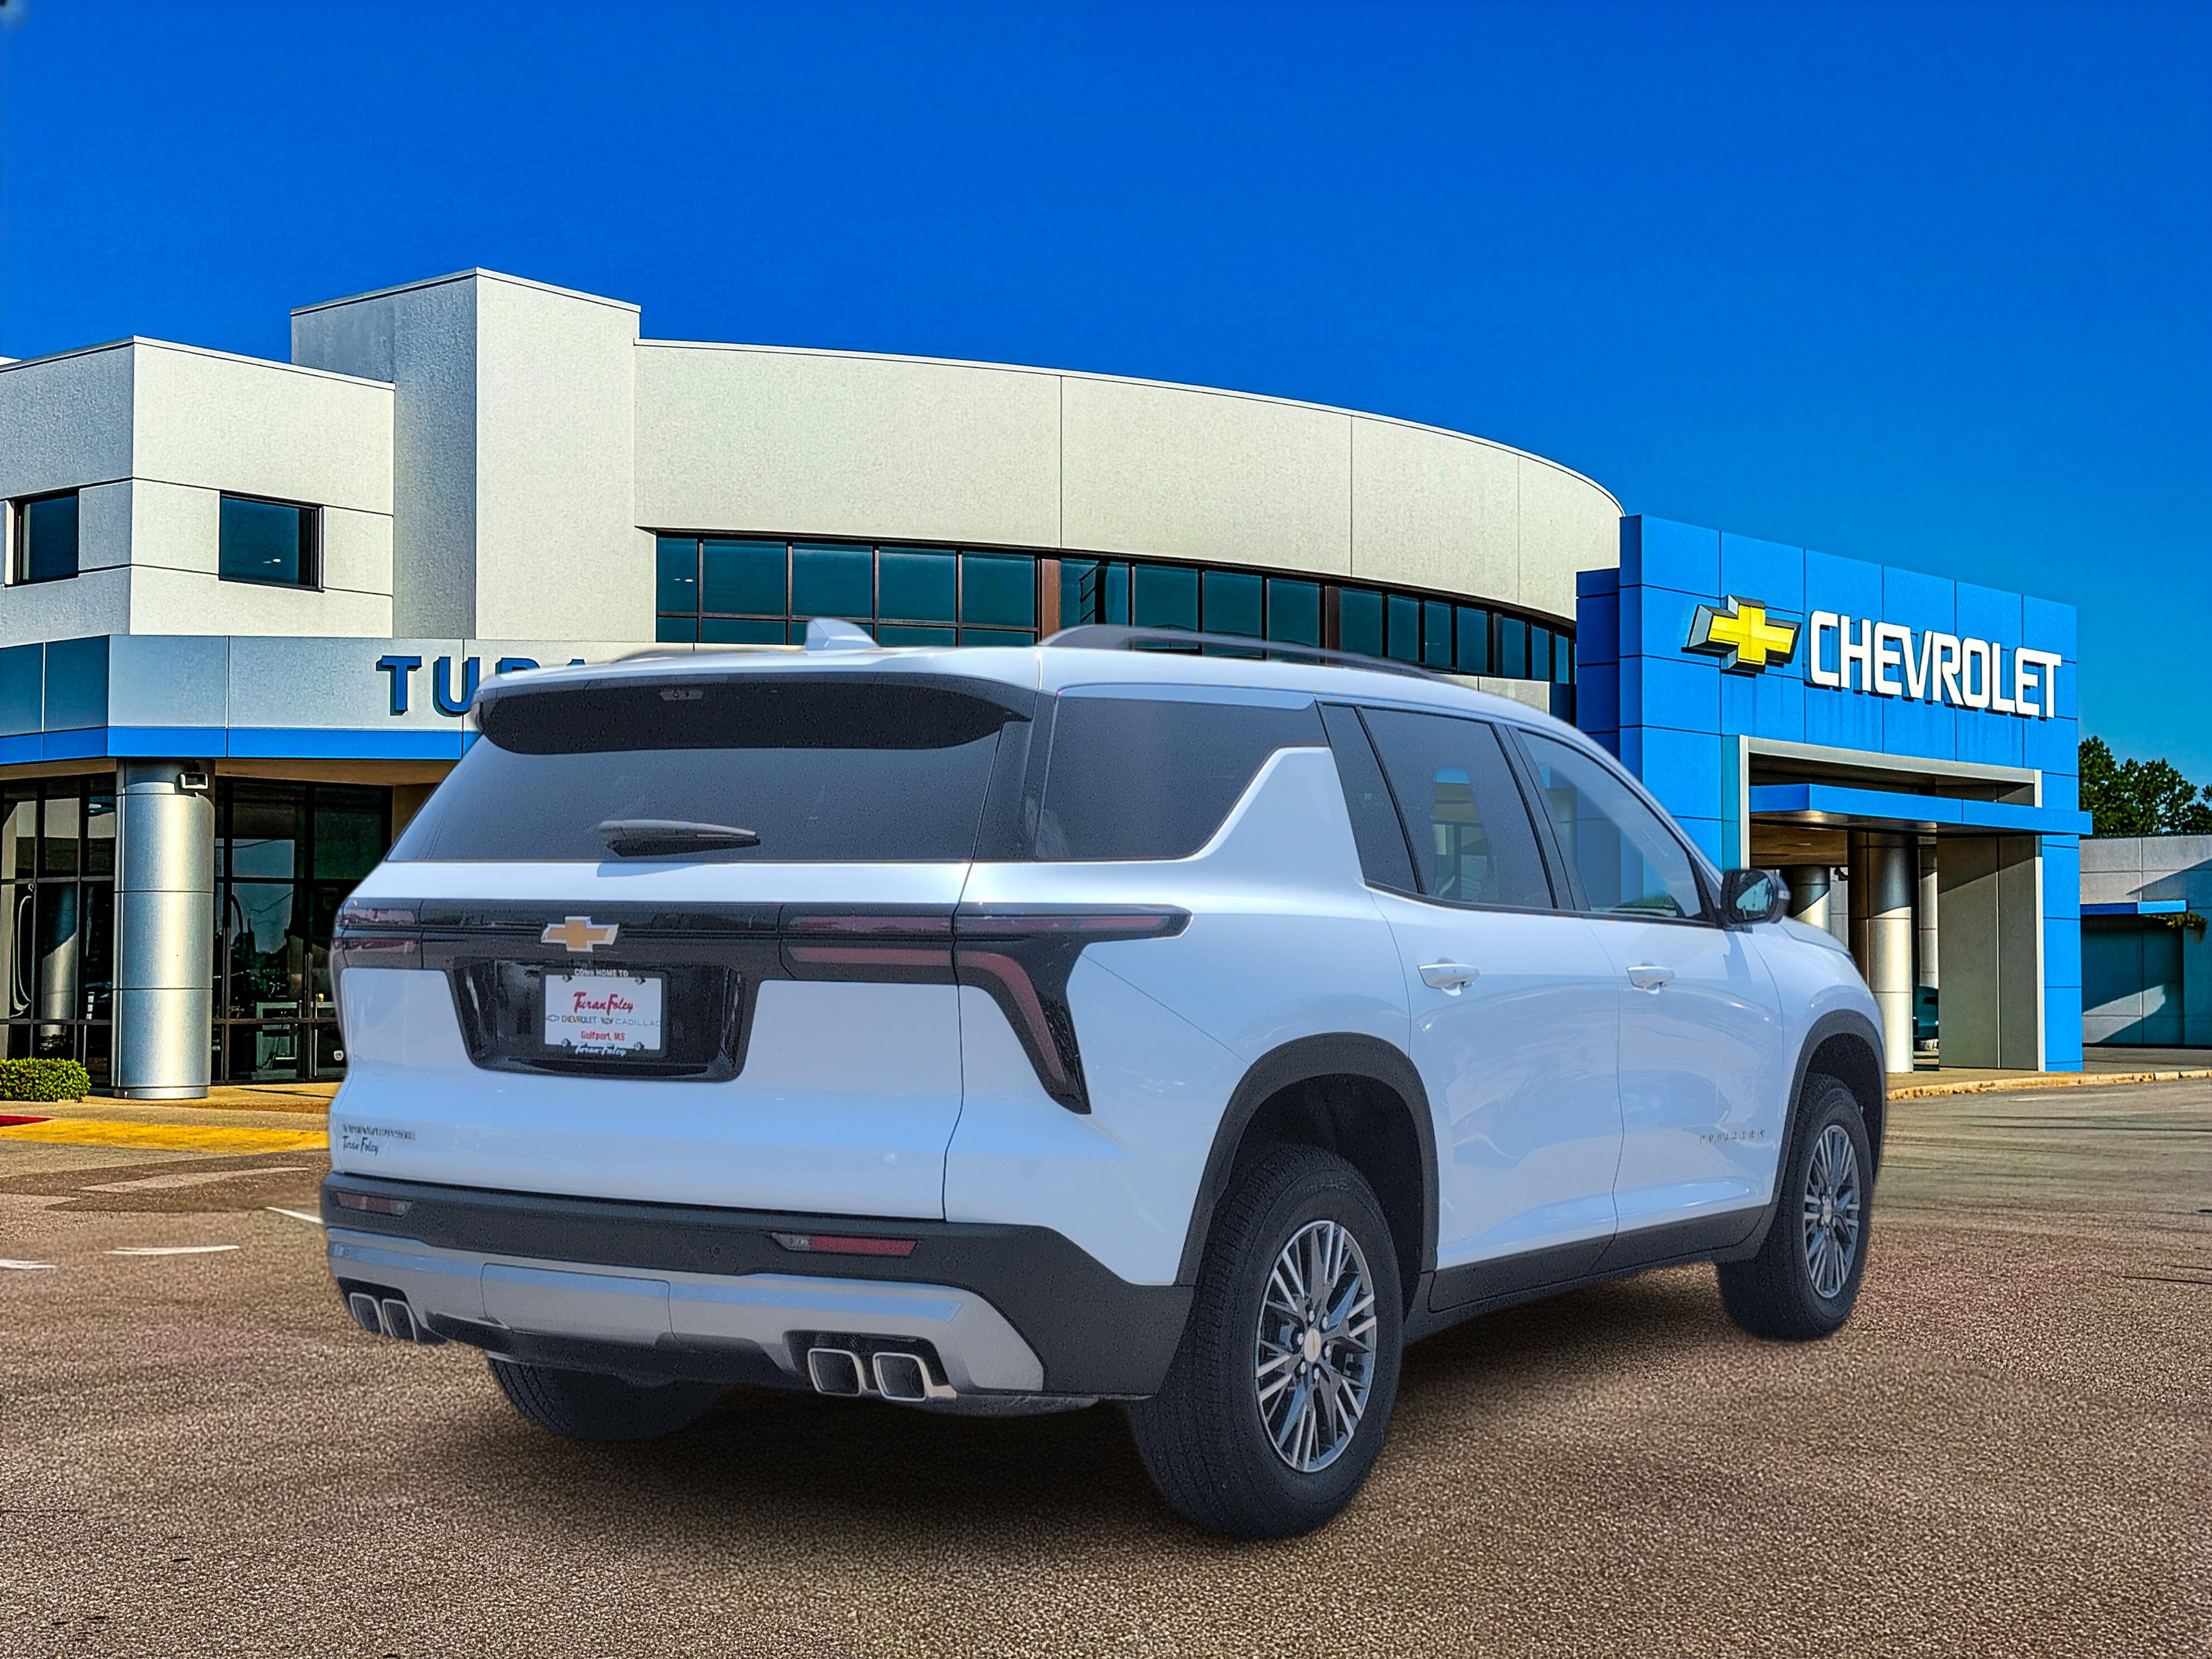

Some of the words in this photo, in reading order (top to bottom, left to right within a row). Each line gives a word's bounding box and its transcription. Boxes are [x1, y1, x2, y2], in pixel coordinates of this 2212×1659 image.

[376, 655, 586, 717] TU
[1810, 609, 2061, 719] CHEVROLET
[614, 1032, 626, 1040] MS
